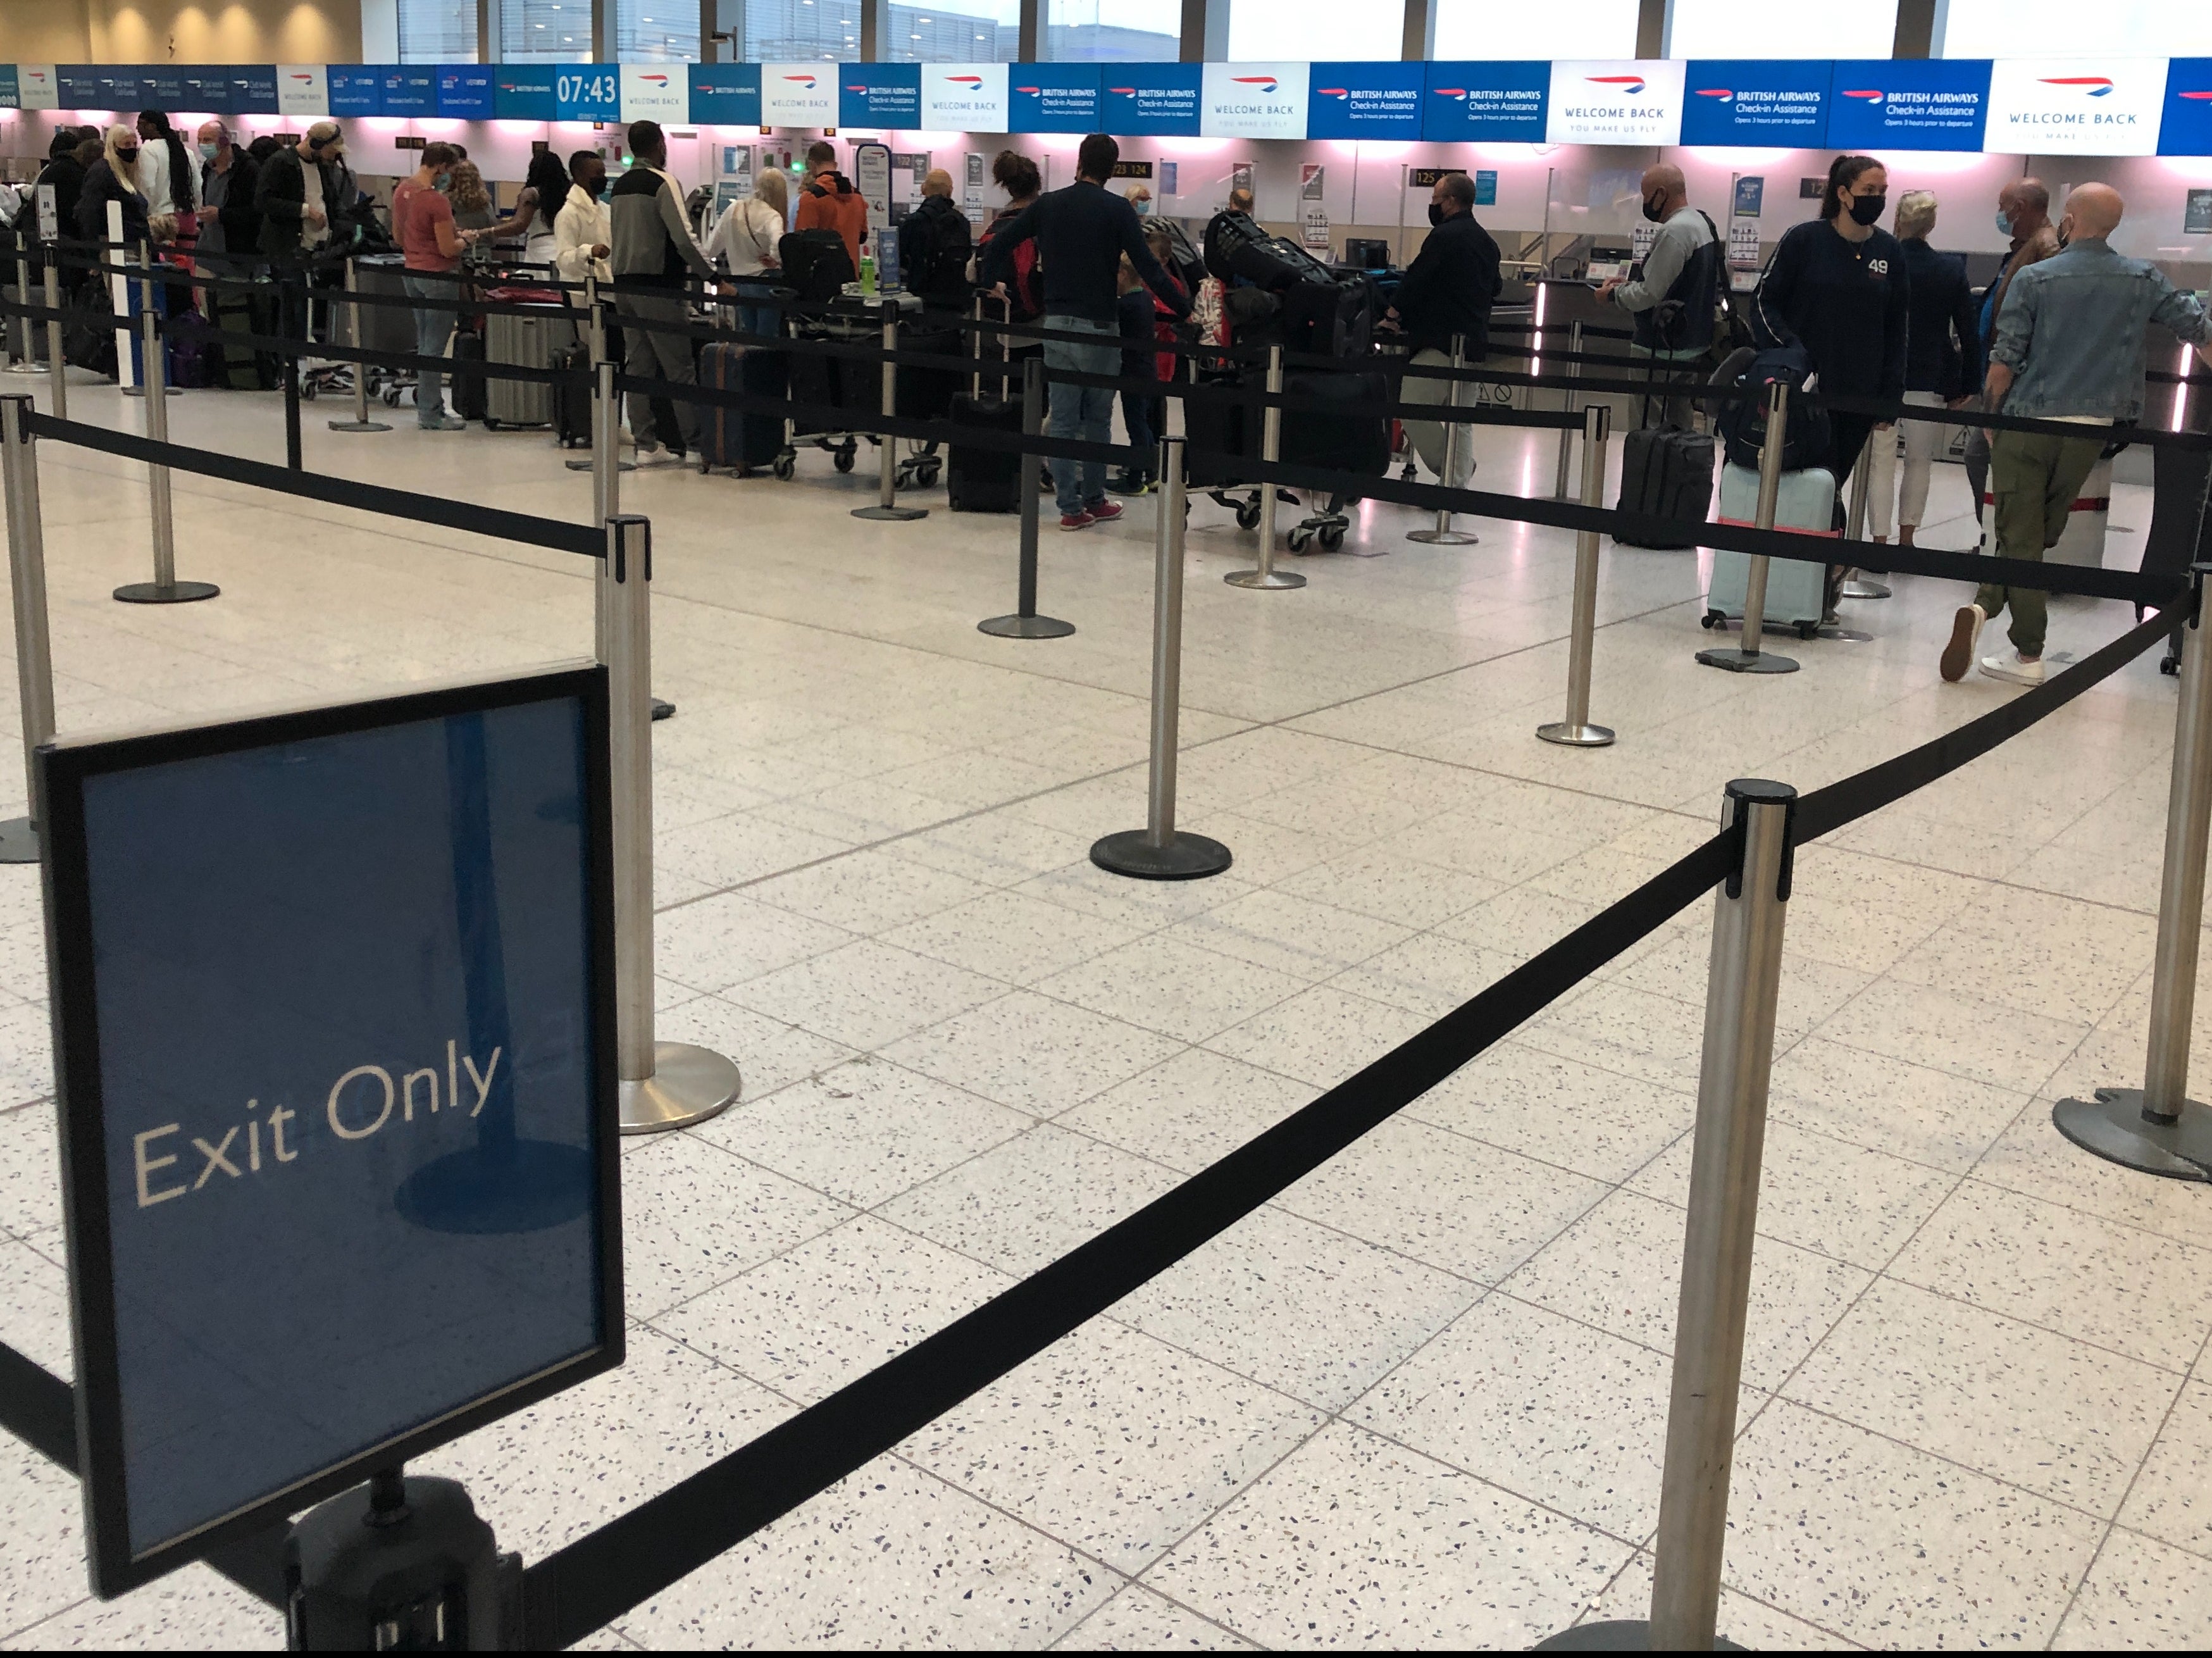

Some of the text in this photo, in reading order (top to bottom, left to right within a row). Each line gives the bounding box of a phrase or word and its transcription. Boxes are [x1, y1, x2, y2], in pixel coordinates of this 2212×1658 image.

[558, 76, 616, 103] 07:43
[1069, 89, 1096, 97] AIRWAYS
[1138, 89, 1196, 98] BRITISH AIRWAYS
[1351, 90, 1417, 99] BRITISH AIRWAYS
[1470, 90, 1541, 100] BRITISH AIRWAYS
[1737, 91, 1821, 102] BRITISH AIRWAYS
[1887, 92, 1979, 104] BRITISH AIRWAYS
[932, 102, 971, 110] WELCOME
[1215, 105, 1293, 115] WELCOME BACK
[1350, 101, 1415, 110] Check-in Assistance
[1469, 101, 1538, 111] Check-in Assistance
[1736, 103, 1817, 114] Check-in Assistance
[1886, 104, 1975, 116] Check-in Assistance
[1565, 108, 1664, 118] WELCOME BACK
[2010, 113, 2137, 125] WELCOME BACK
[1417, 171, 1435, 184] 125
[1868, 258, 1888, 275] 49
[133, 1039, 502, 1208] Exit Only
